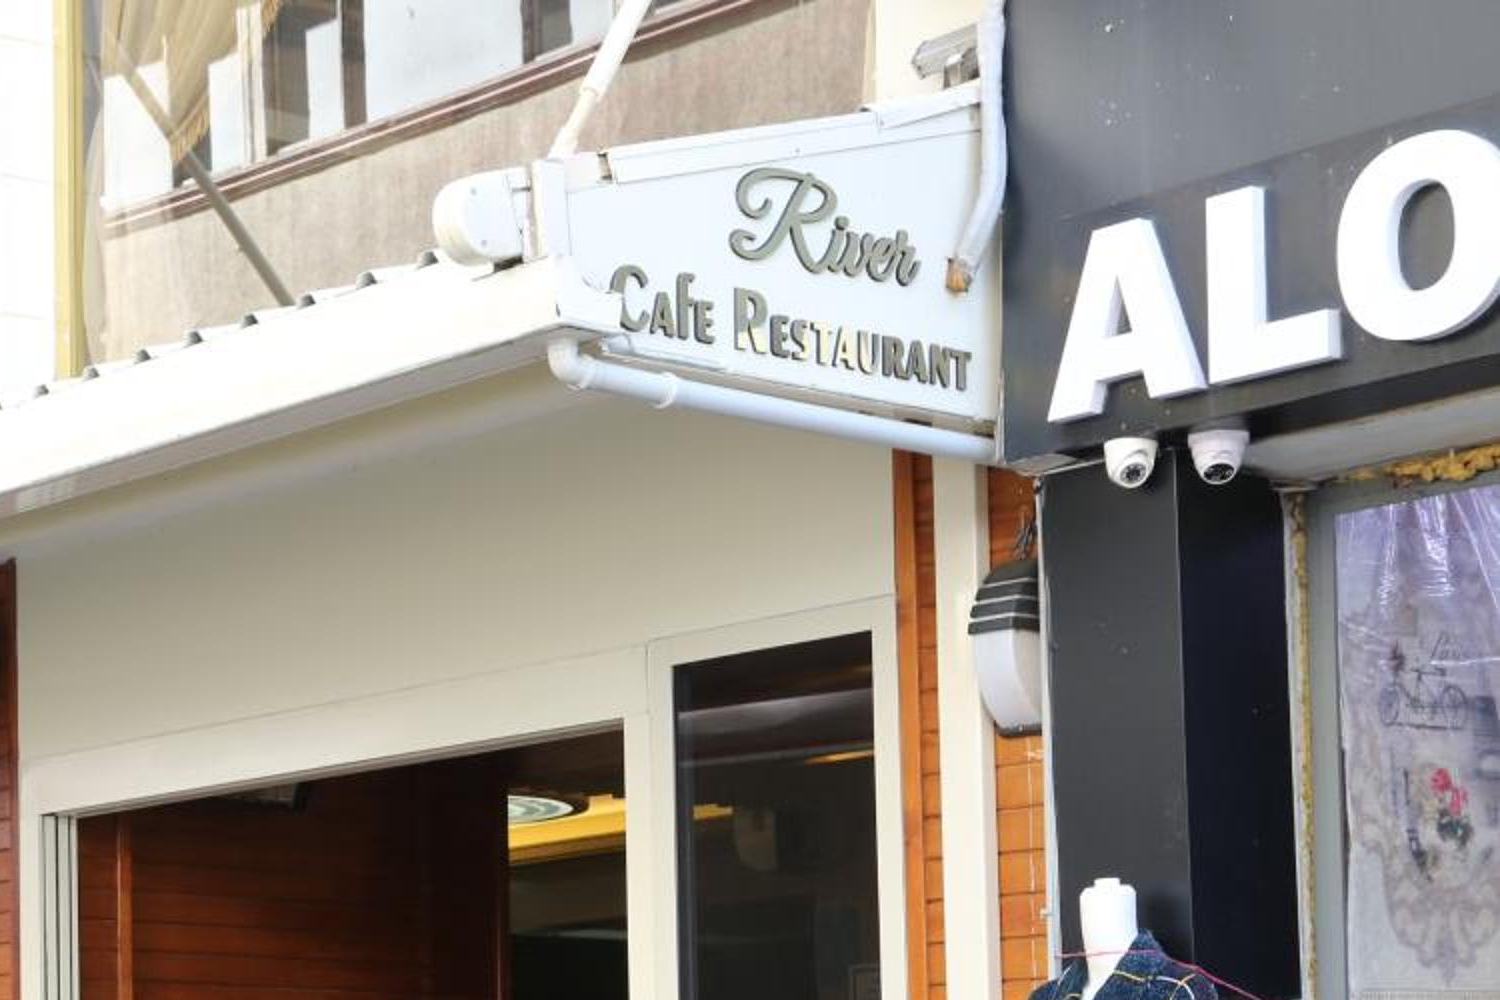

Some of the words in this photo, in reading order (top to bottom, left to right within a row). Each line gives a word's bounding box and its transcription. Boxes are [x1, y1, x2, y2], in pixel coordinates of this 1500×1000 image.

[728, 166, 922, 288] River
[1047, 128, 1500, 423] ALO
[732, 286, 973, 393] RESTAURANT
